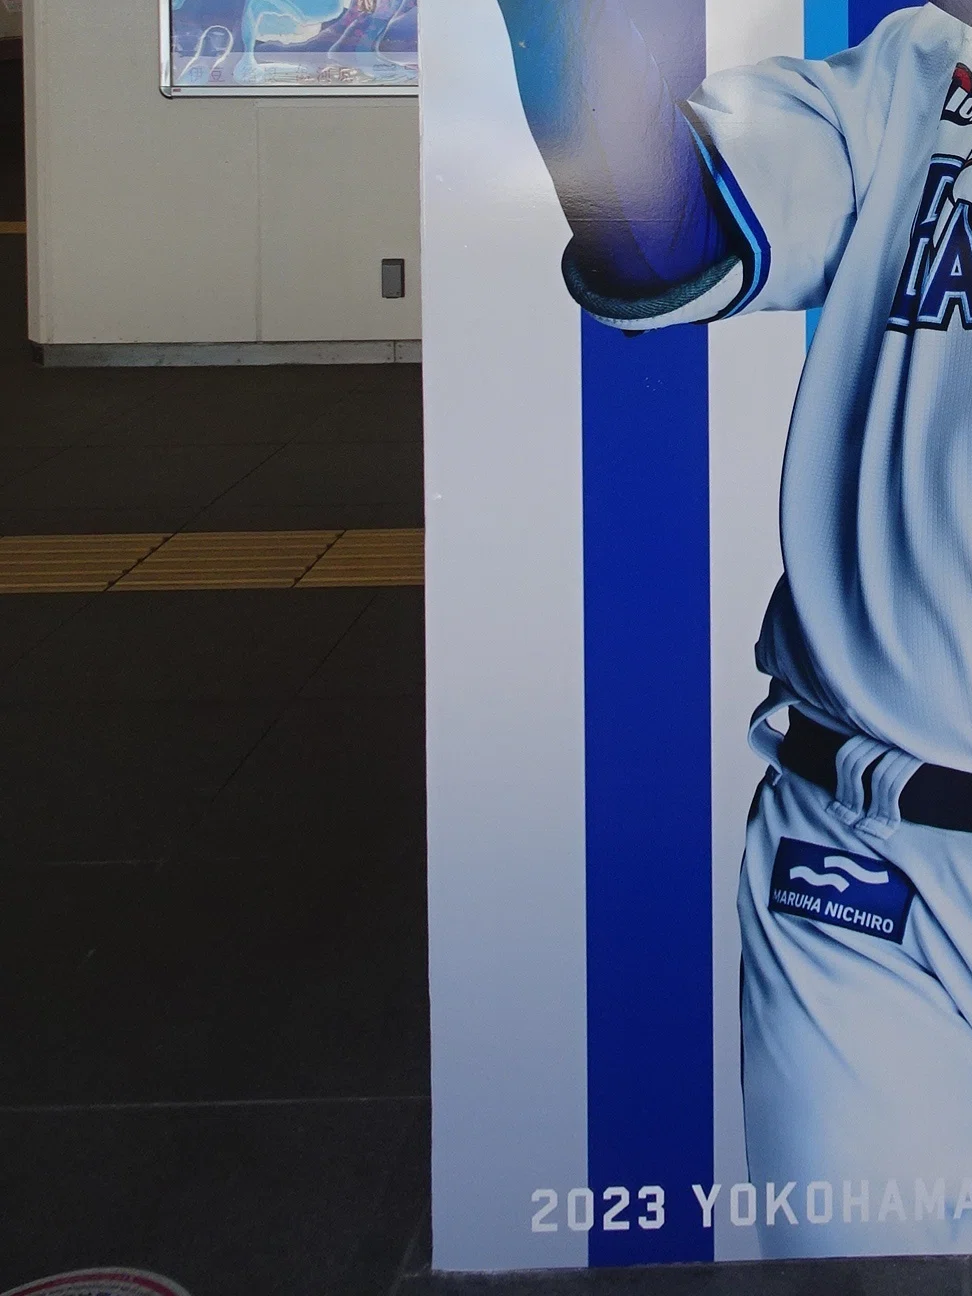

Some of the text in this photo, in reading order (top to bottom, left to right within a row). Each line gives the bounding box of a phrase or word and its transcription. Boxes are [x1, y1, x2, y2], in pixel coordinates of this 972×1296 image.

[772, 888, 894, 934] MARUHA NICHIRO
[531, 1184, 665, 1233] 2023
